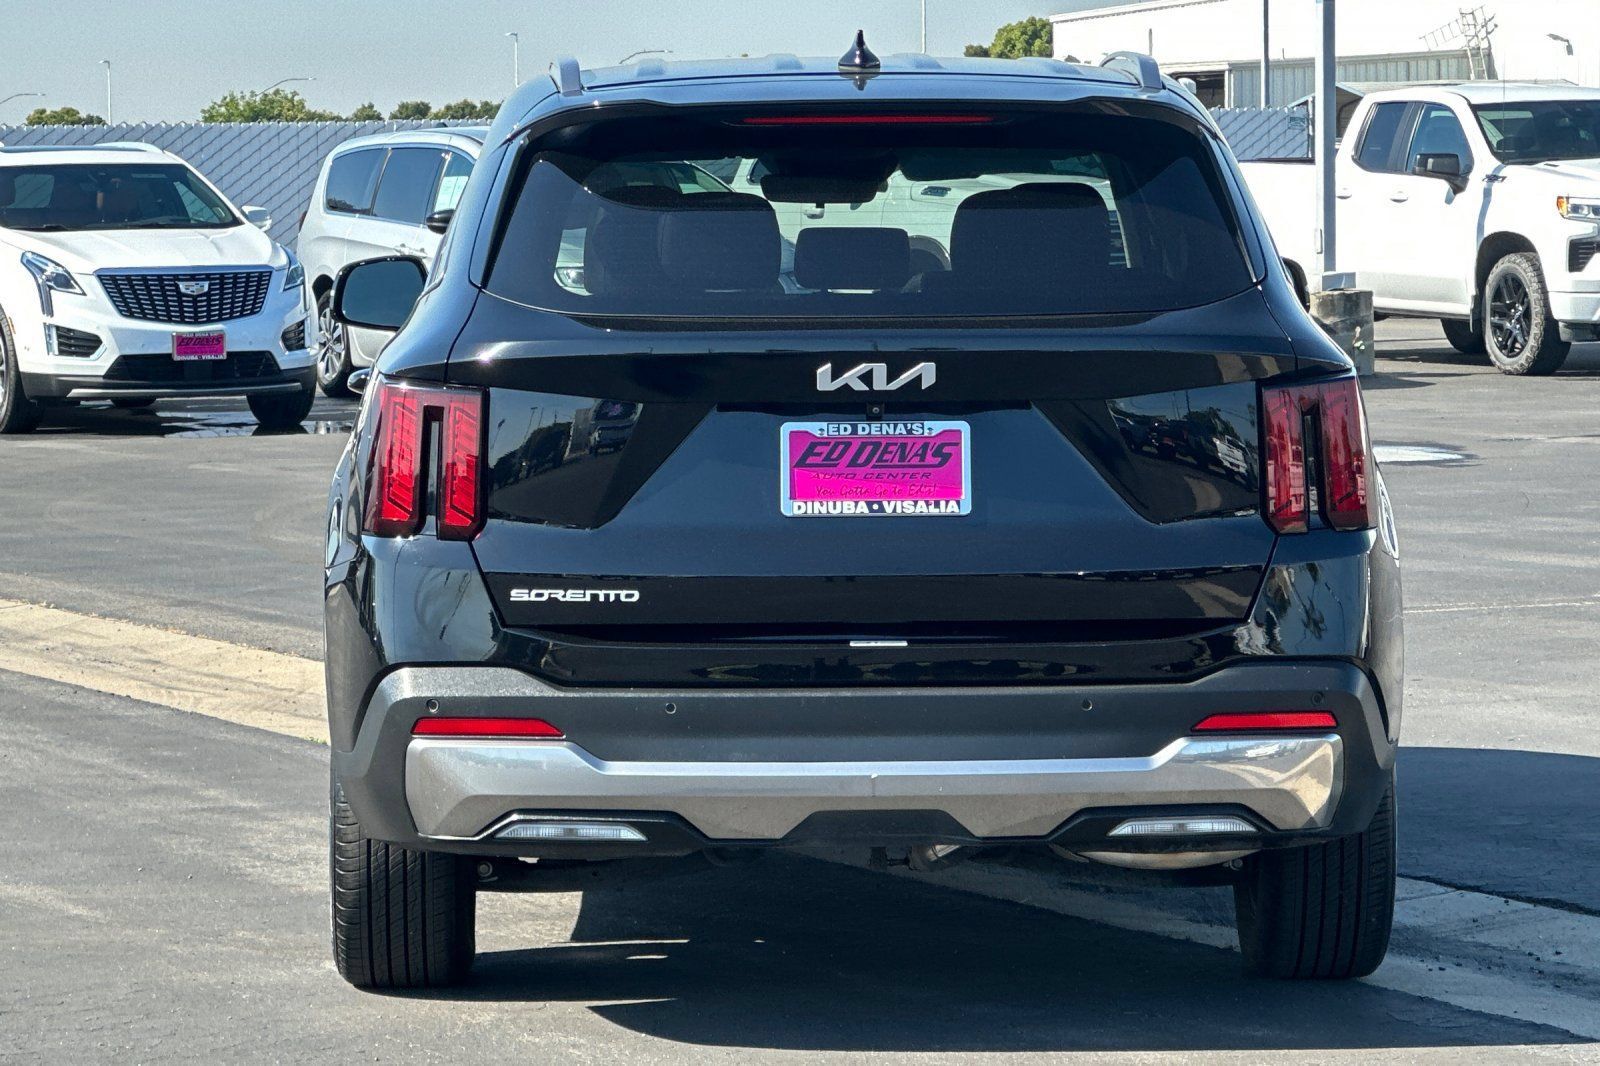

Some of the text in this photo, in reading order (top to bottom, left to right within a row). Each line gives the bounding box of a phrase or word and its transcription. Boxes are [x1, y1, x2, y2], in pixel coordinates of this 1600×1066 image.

[816, 362, 936, 391] KIA
[828, 423, 924, 435] ED DENA'S
[793, 441, 960, 469] ED DENA'S
[811, 472, 932, 480] AUTO CENTER
[816, 485, 835, 496] You
[874, 485, 888, 497] Go
[891, 485, 902, 496] to
[793, 500, 960, 515] DINUBA VISALIA
[510, 588, 640, 602] SORENTO
